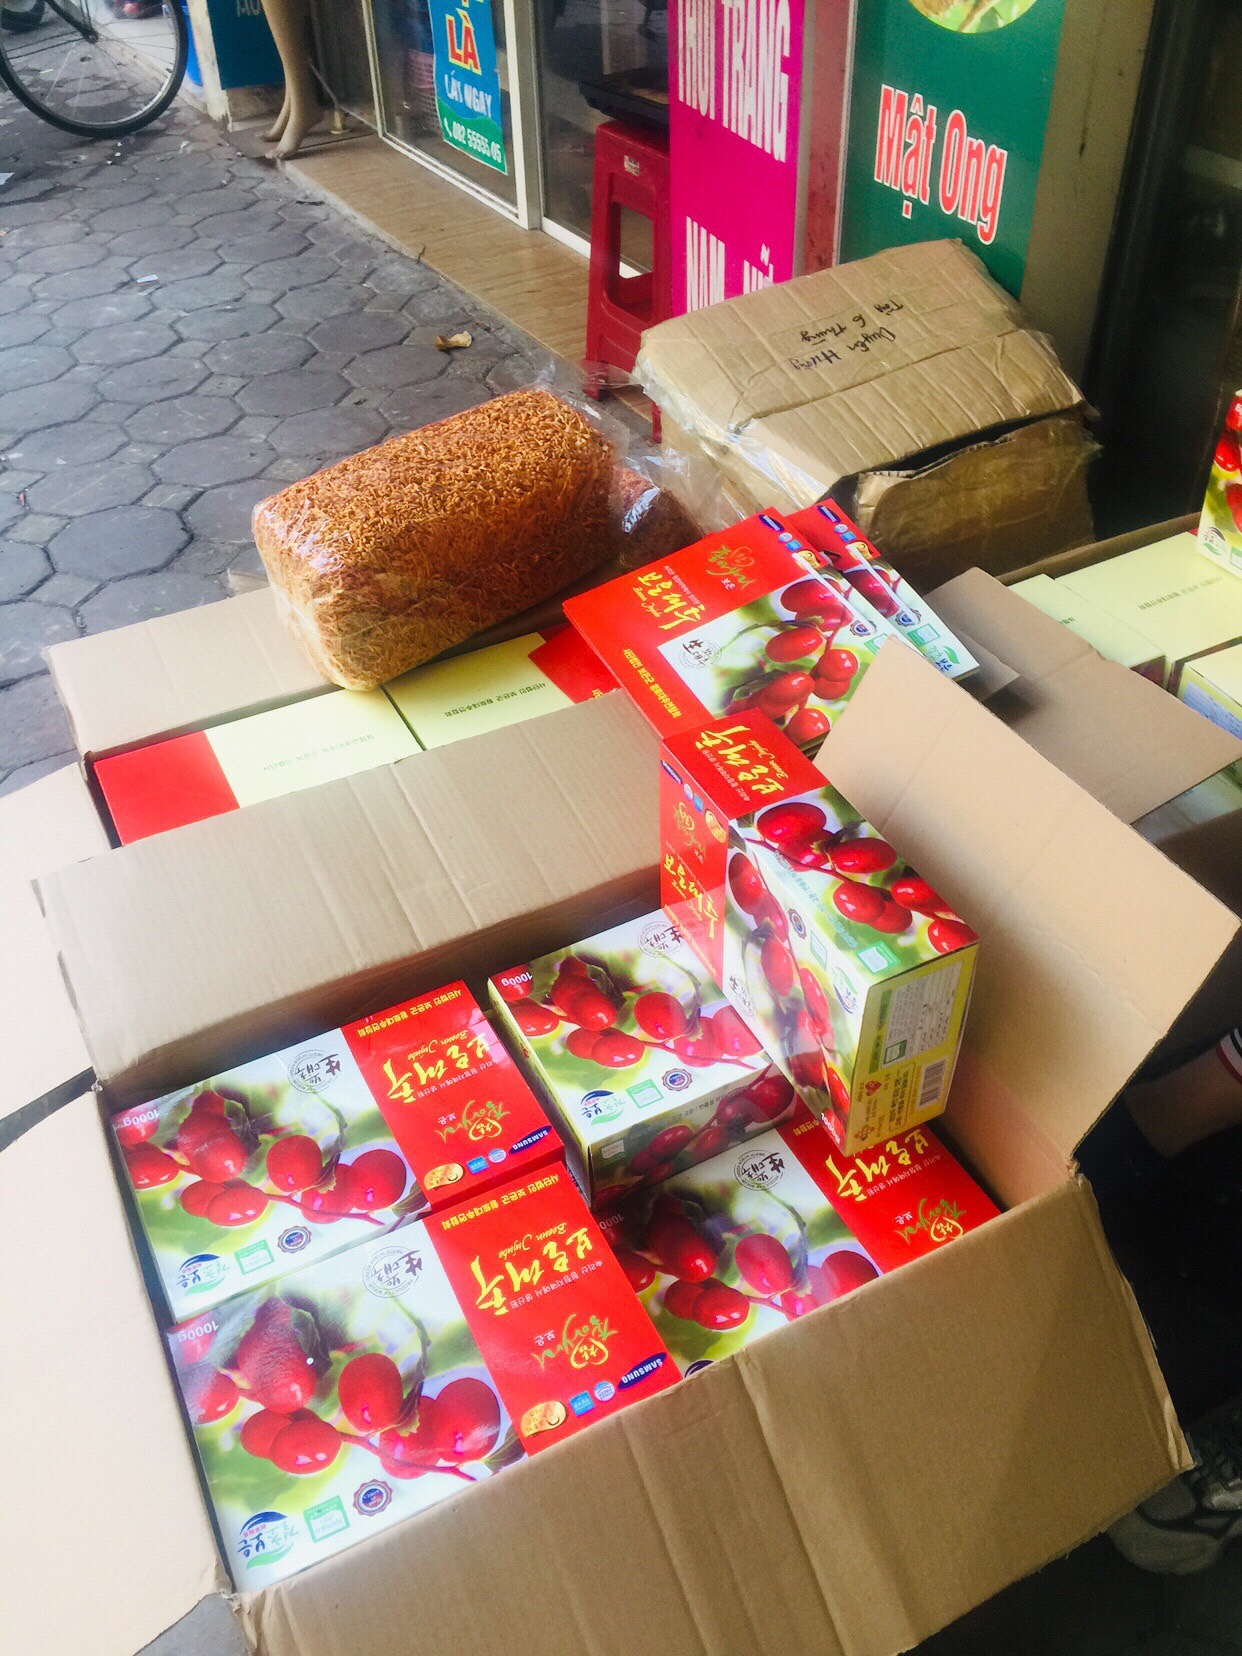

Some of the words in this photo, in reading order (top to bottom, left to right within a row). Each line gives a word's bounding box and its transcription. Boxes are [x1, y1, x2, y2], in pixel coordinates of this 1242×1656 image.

[445, 8, 482, 76] LÀ
[722, 0, 791, 163] TRANG
[464, 83, 492, 118] NGAY
[874, 83, 938, 220] Mật
[939, 109, 1008, 246] Ong
[637, 571, 706, 631] 보은대추
[695, 725, 785, 795] 보은대추
[501, 971, 533, 987] 1000g
[410, 1002, 433, 1016] 보은군
[434, 990, 463, 1006] 사단법인
[357, 1011, 409, 1038] 황토대추연합회
[382, 1033, 491, 1104] 보은대추
[123, 1109, 160, 1127] 1000g
[437, 1112, 457, 1126] 보은
[512, 1130, 549, 1151] SAMSUNG
[824, 1129, 929, 1202] 보은대추
[529, 1173, 560, 1194] 사단법인
[500, 1188, 527, 1206] 보은군
[441, 1199, 499, 1231] 황토대추연합회
[600, 1213, 625, 1231] 1000
[894, 1210, 913, 1225] 보은
[469, 1226, 593, 1317] 보은대추
[178, 1320, 220, 1343] 1000g
[534, 1329, 557, 1347] 보은
[621, 1358, 664, 1385] SAMSUNG
